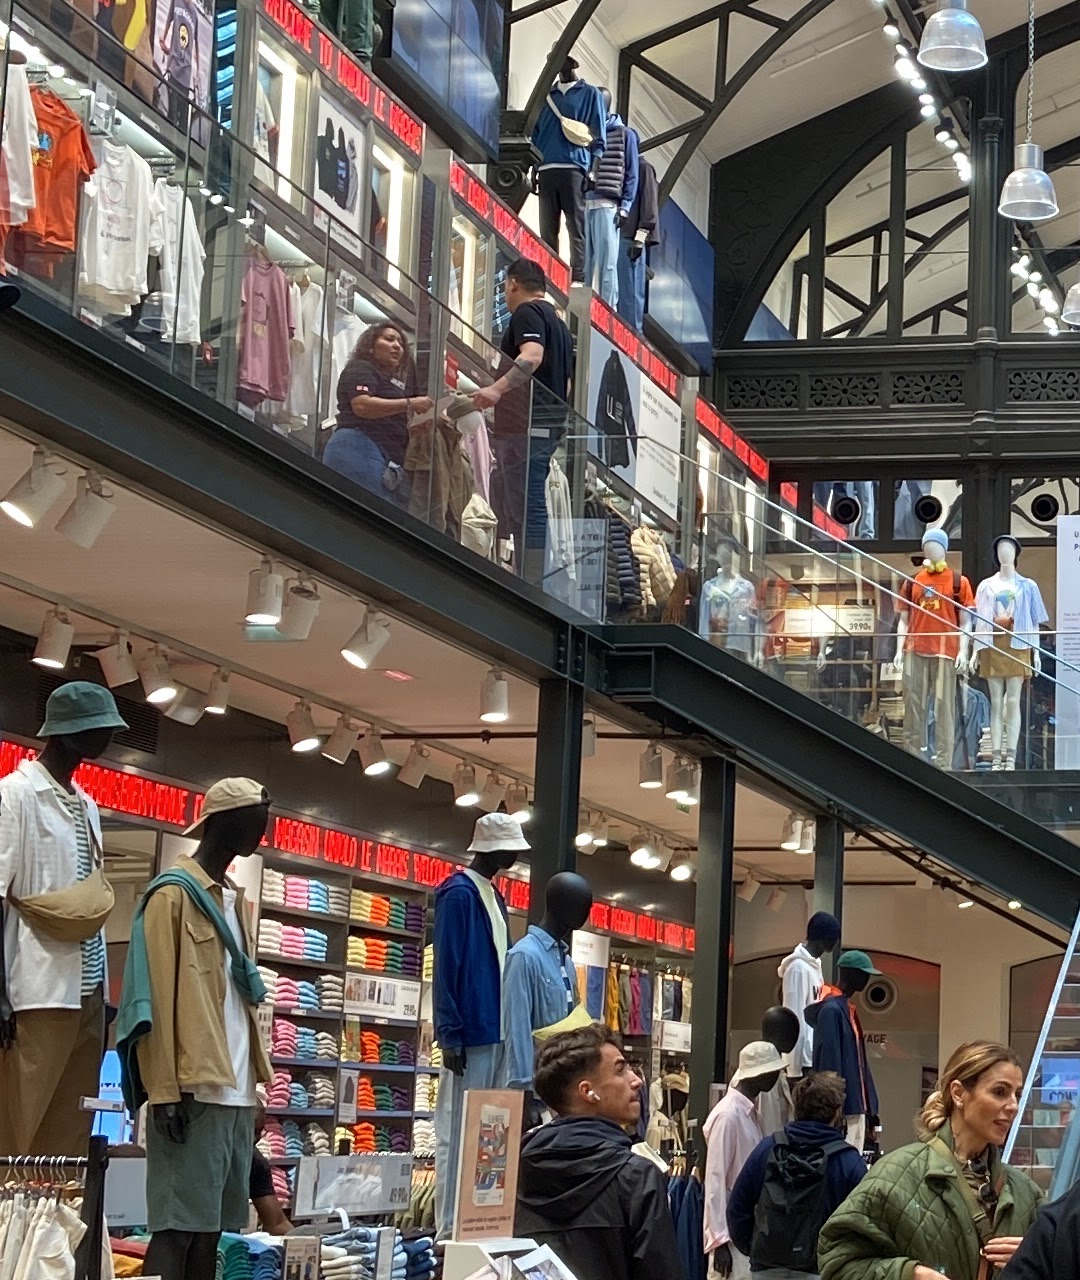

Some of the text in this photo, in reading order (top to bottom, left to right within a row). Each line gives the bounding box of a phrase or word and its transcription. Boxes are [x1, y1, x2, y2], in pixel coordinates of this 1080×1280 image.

[319, 32, 333, 70] TO
[374, 87, 386, 122] LE
[360, 839, 373, 872] LE
